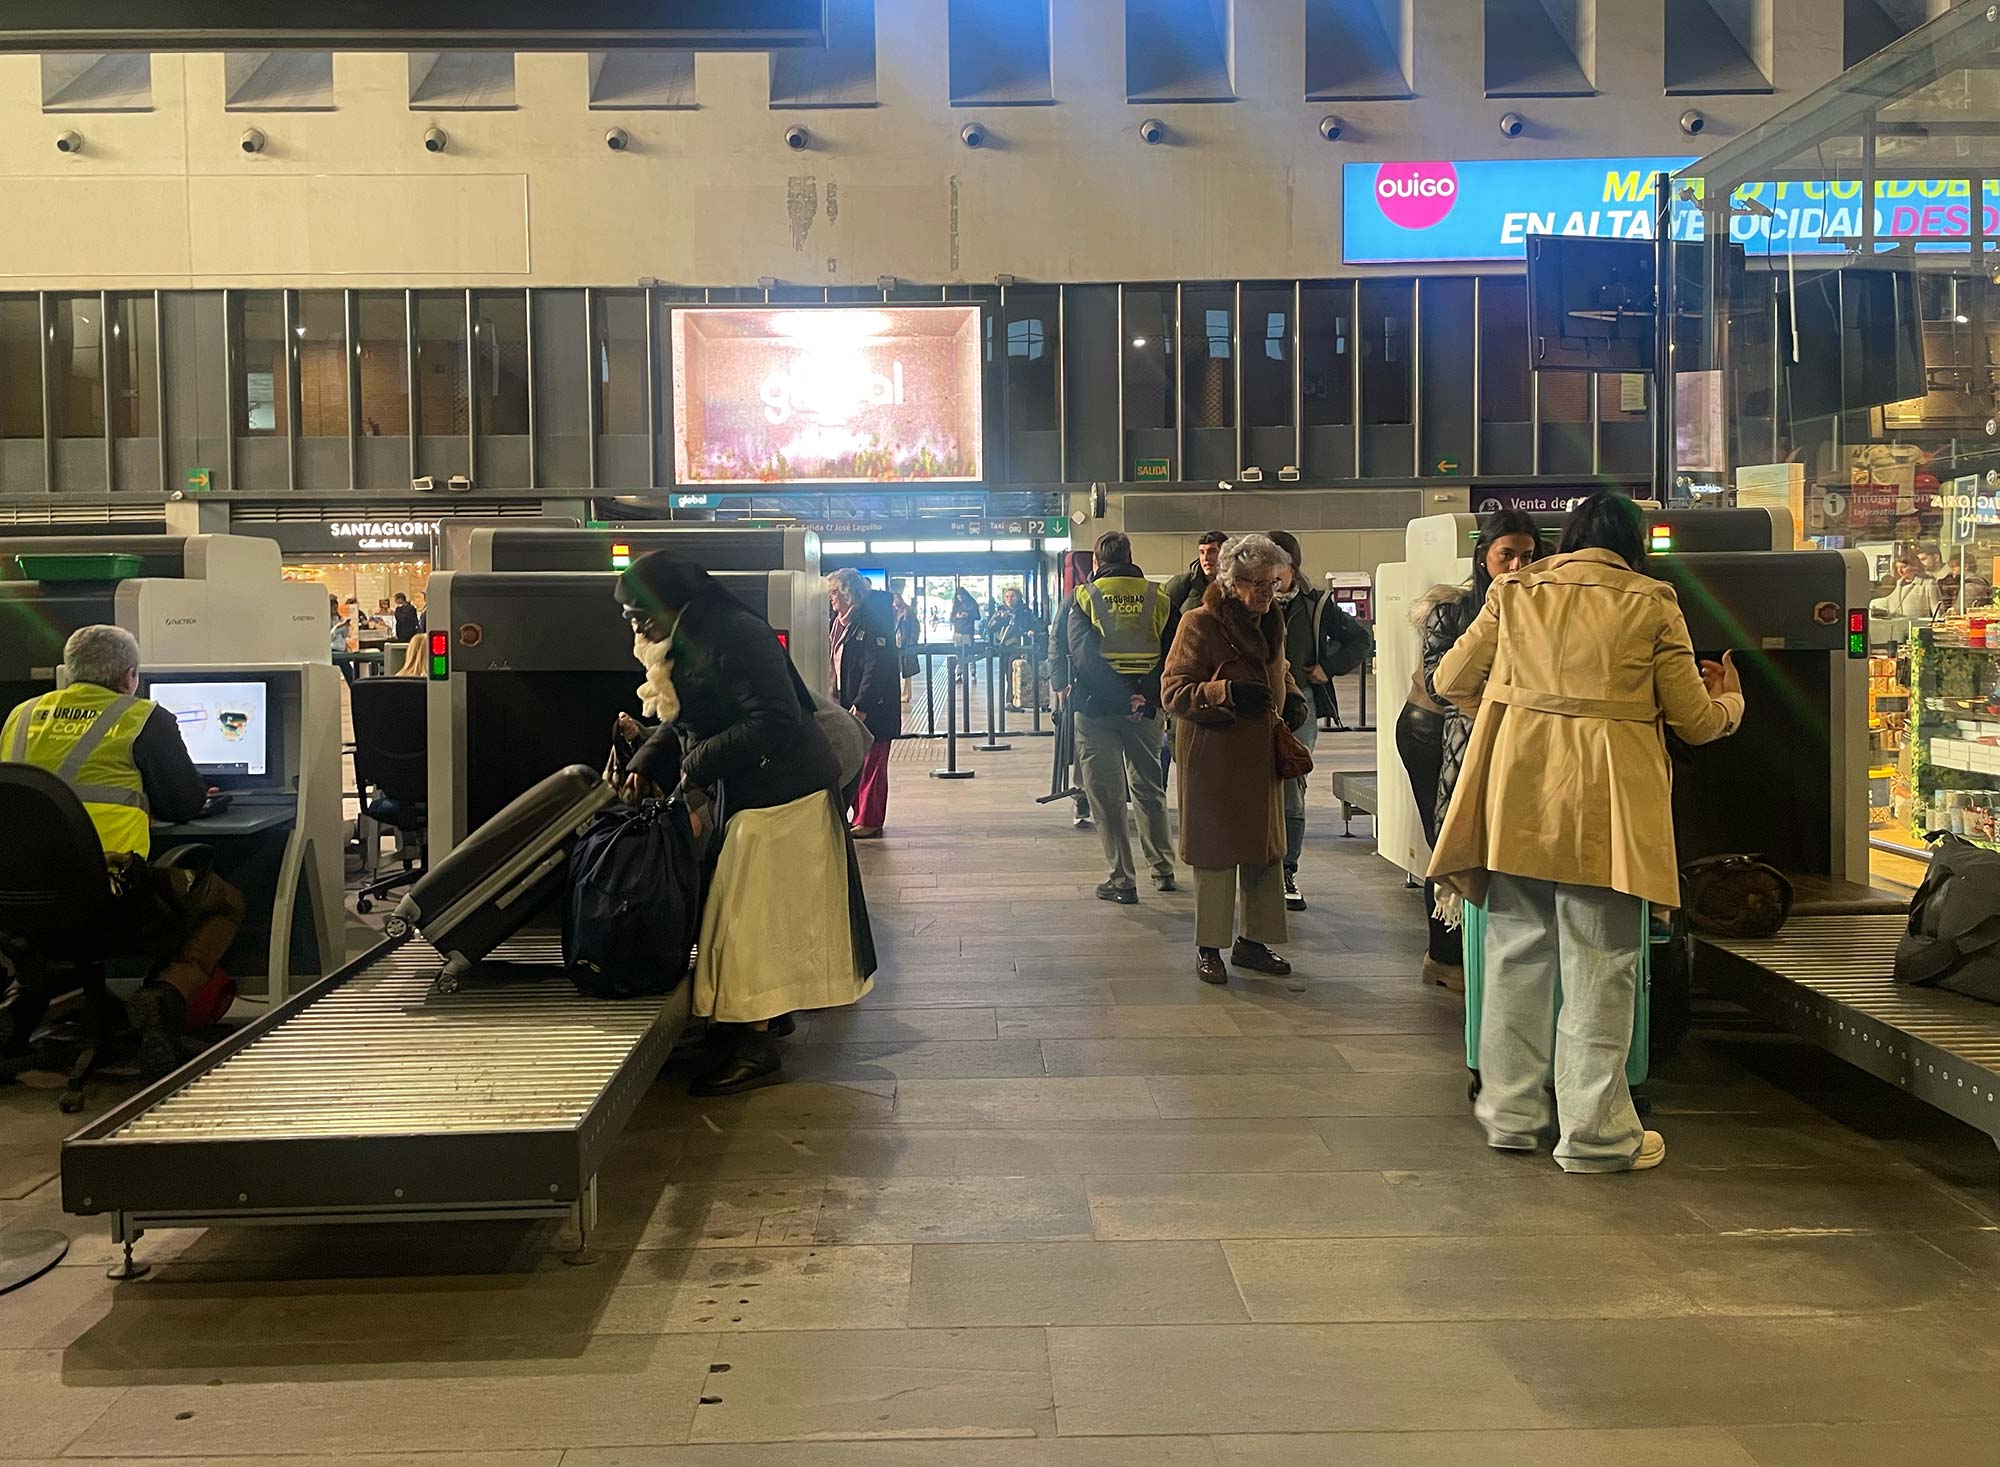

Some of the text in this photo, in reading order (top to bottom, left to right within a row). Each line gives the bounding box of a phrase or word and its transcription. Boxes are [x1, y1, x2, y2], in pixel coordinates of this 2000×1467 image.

[1137, 466, 1167, 475] SALIDA
[678, 494, 707, 508] global
[1511, 496, 1566, 509] Venta de
[834, 523, 851, 532] José
[853, 523, 882, 533] Laguillo
[951, 521, 1045, 534] Bus Taxi P2
